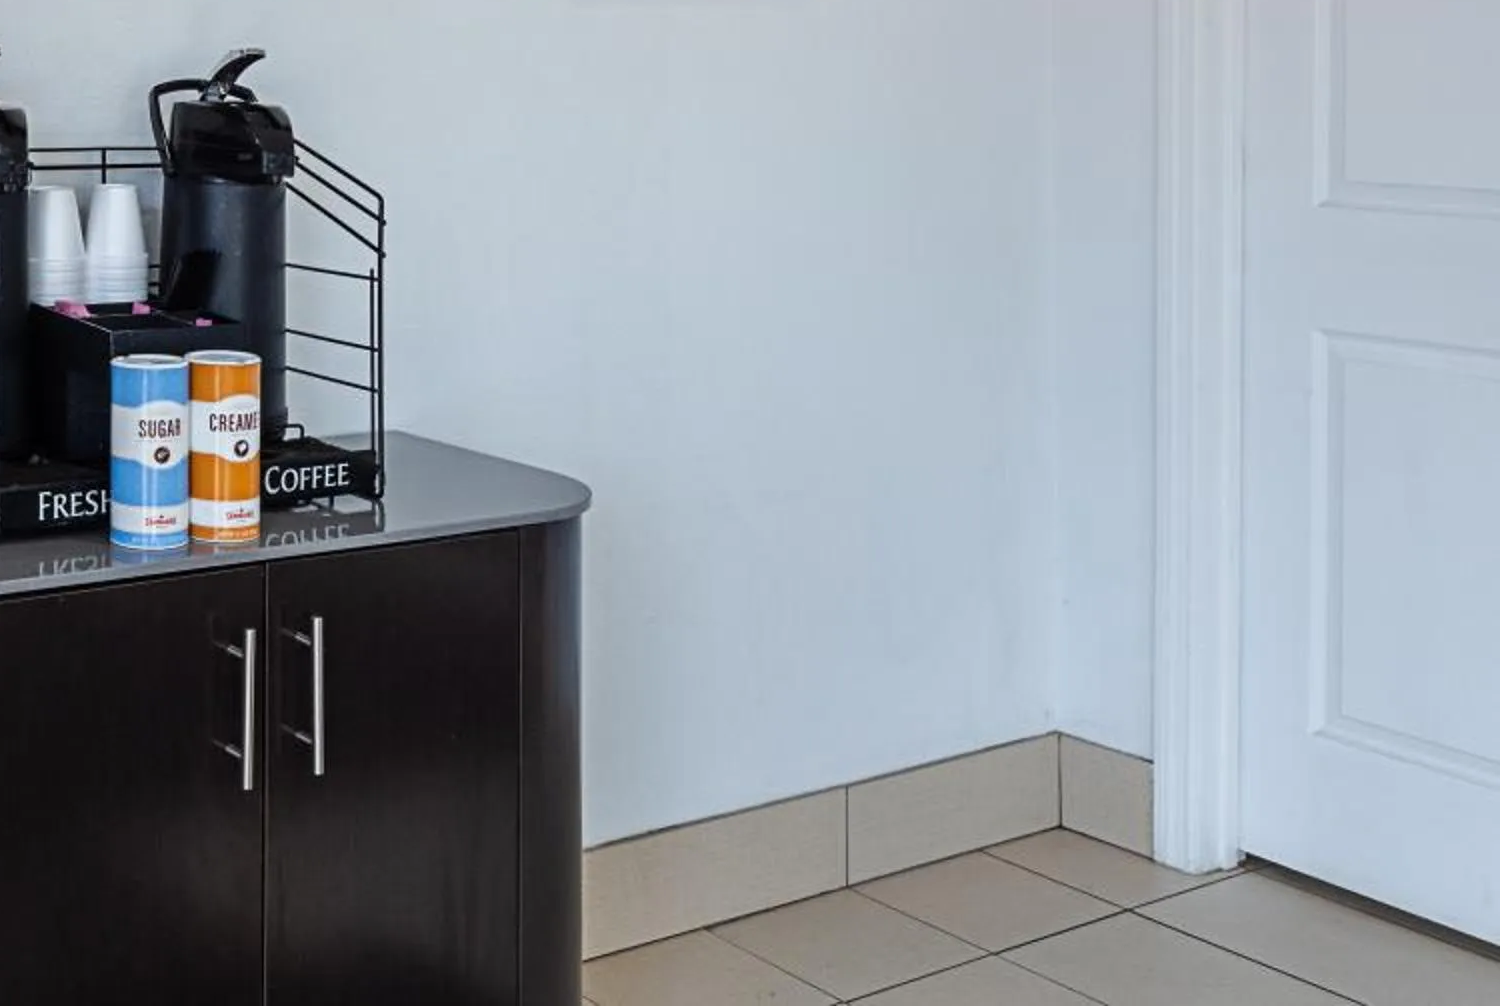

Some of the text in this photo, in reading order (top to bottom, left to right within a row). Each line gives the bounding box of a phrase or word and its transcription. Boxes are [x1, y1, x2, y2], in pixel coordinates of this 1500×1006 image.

[138, 417, 181, 439] SUGAR
[38, 462, 350, 522] FRESH COFFEE
